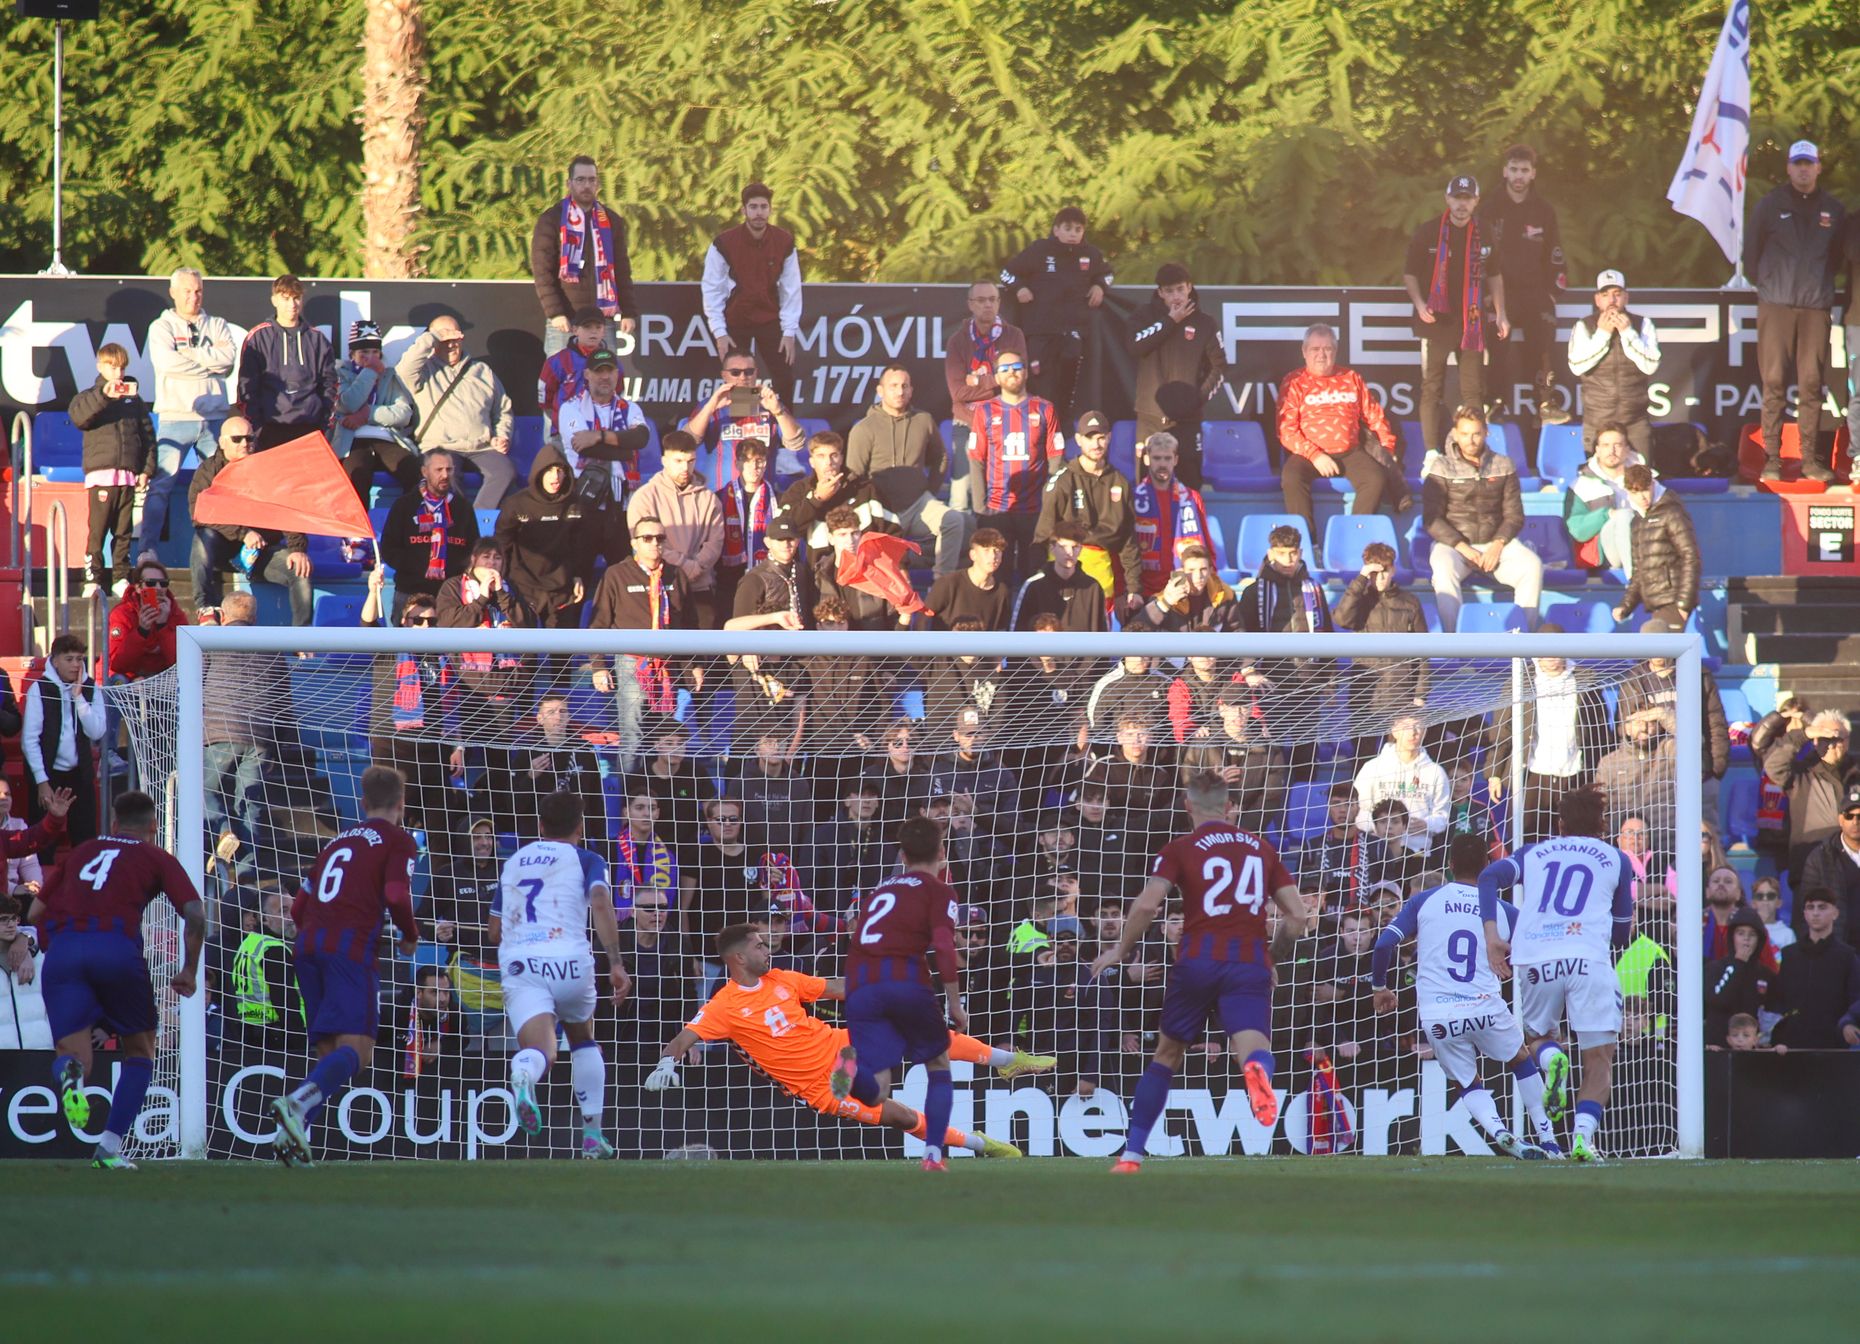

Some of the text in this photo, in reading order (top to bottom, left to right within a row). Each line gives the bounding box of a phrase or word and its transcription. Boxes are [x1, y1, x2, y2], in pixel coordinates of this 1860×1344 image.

[793, 305, 947, 359] MÓVIL
[621, 376, 692, 403] LLAMA
[1304, 390, 1358, 405] adidas
[1810, 517, 1853, 529] SECTOR
[1820, 532, 1842, 561] E
[1195, 832, 1260, 851] TIMOR SVA
[79, 849, 120, 891] 4
[520, 855, 559, 867] ELADY
[1536, 844, 1613, 869] ALEXANDRE
[318, 847, 352, 903] 6
[1203, 854, 1264, 917] 24
[1537, 861, 1594, 917] 10
[516, 878, 544, 923] 7
[1444, 900, 1482, 918] ÁNGE
[861, 892, 896, 944] 2
[527, 957, 580, 981] EAVE
[1447, 929, 1478, 983] 9
[1541, 957, 1589, 983] EAVE
[223, 1064, 519, 1161] Goup
